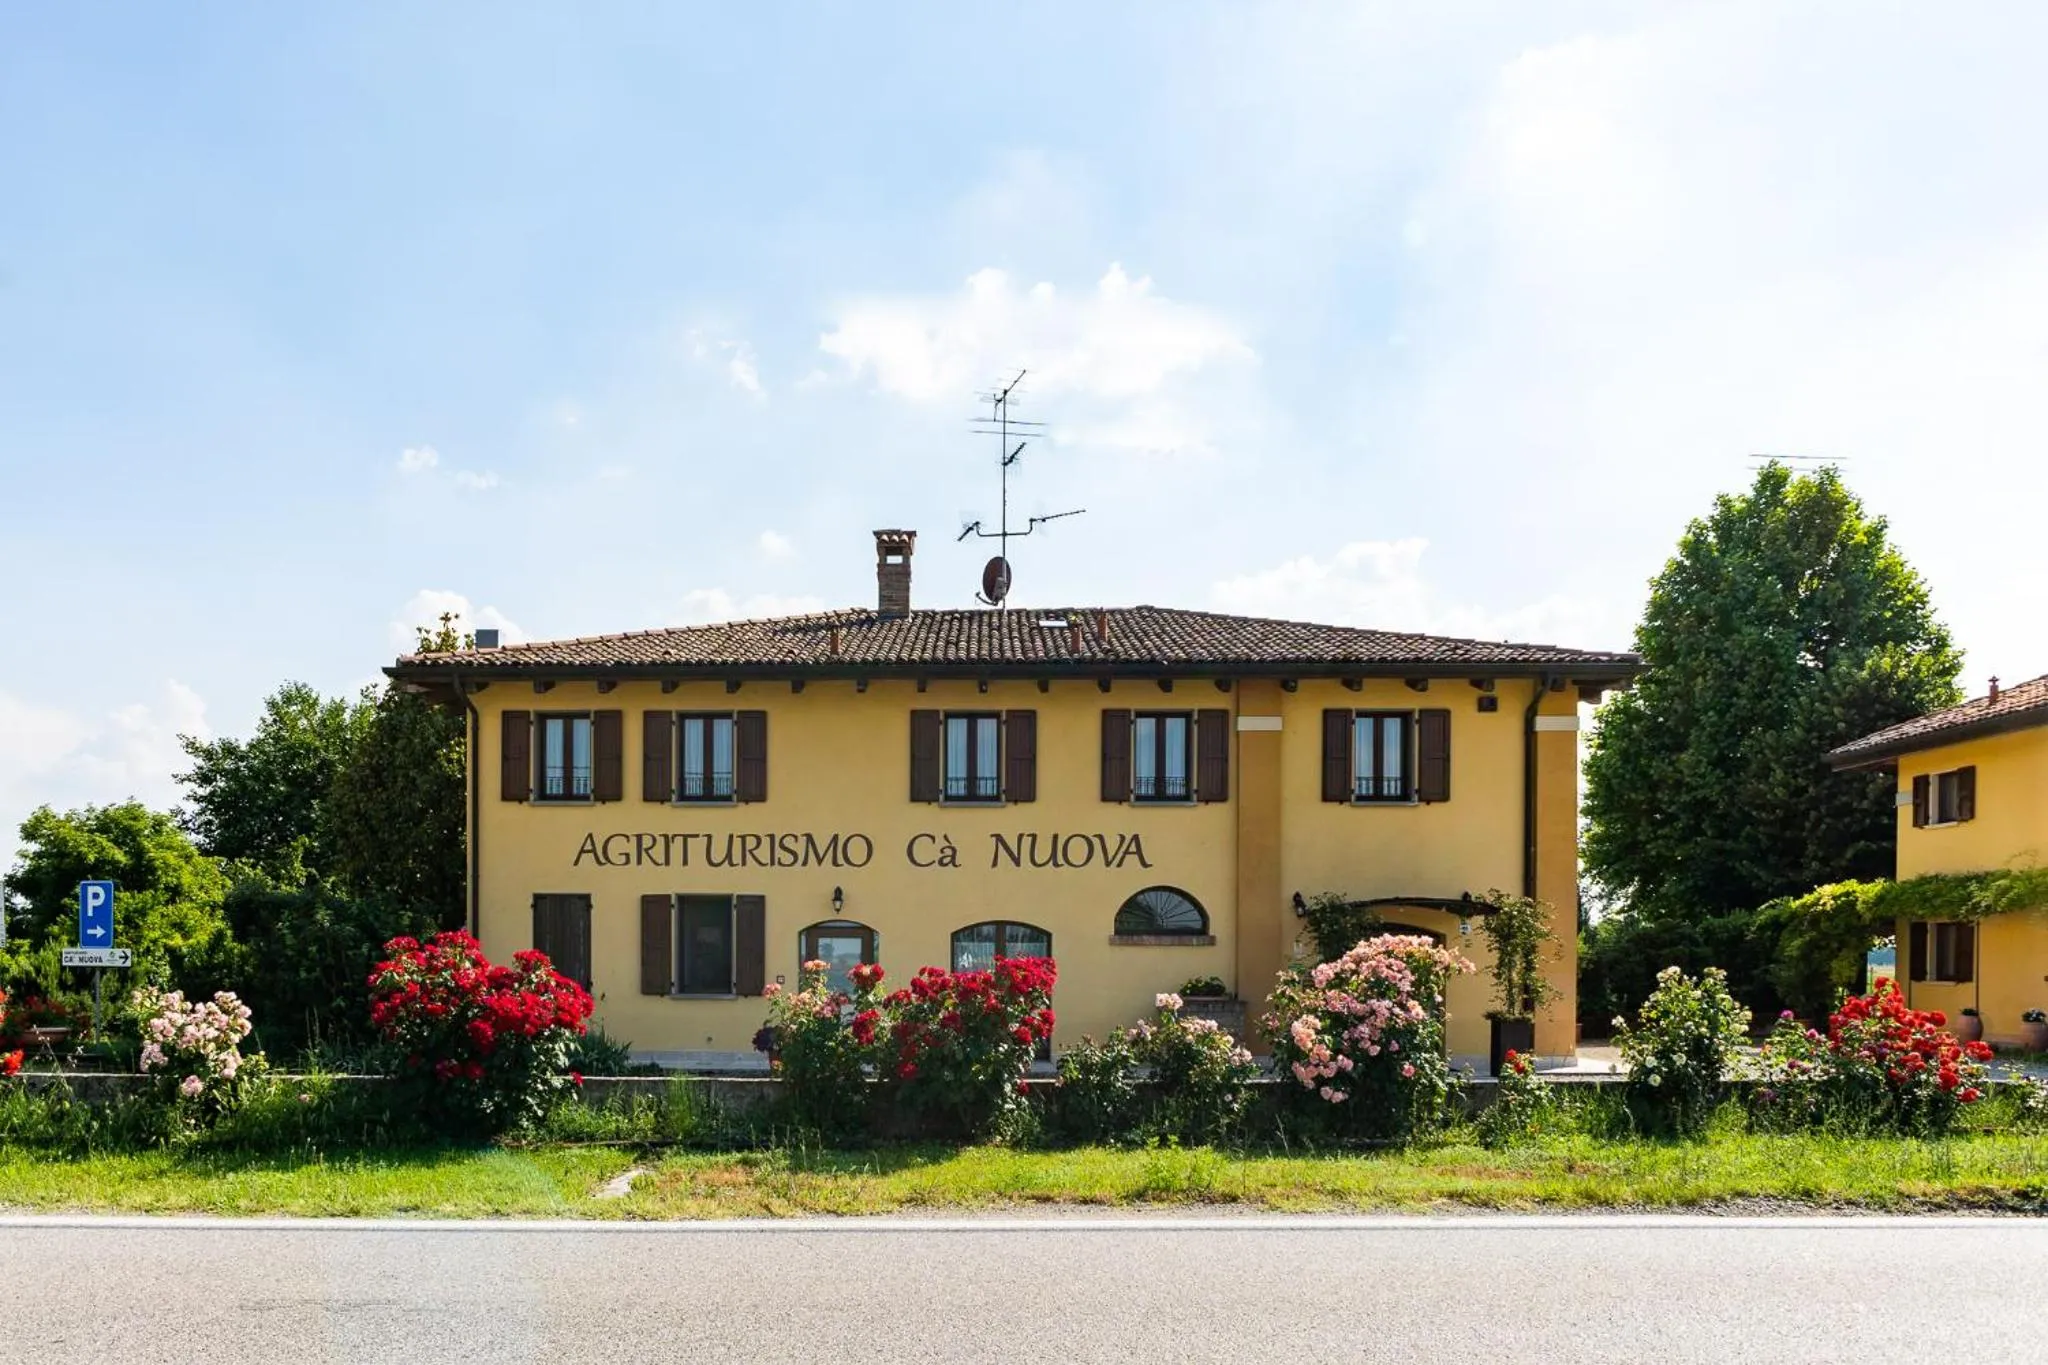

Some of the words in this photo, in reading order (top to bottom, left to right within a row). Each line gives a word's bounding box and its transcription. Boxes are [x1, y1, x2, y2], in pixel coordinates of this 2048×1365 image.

[573, 832, 873, 868] AGRITURISMO
[906, 832, 962, 869] Cà
[990, 832, 1153, 869] NUOVA
[87, 885, 106, 917] P
[78, 955, 104, 964] NUOVA
